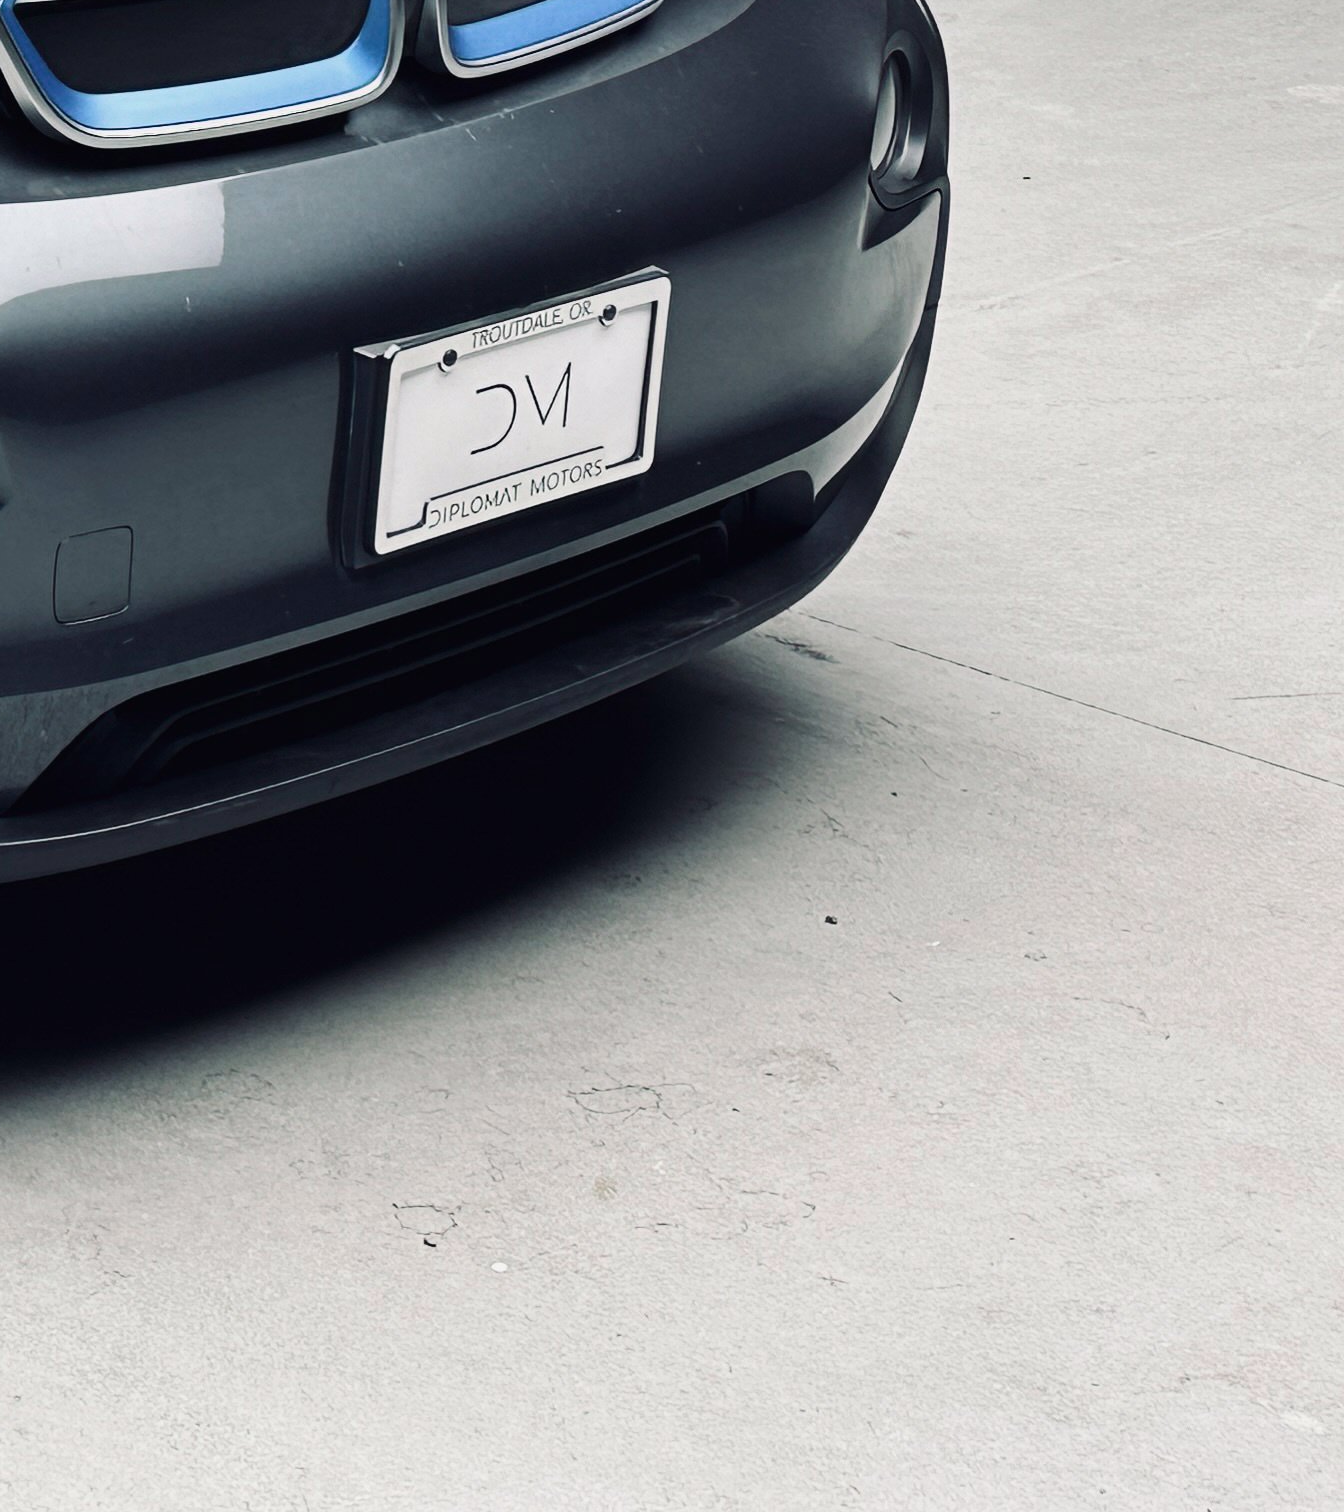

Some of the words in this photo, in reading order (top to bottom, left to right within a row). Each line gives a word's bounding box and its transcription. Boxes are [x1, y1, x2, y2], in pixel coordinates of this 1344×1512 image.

[471, 308, 564, 349] TROUTDALE
[569, 299, 594, 321] OR
[428, 482, 522, 529] DIPLOMAT
[529, 459, 603, 497] MOTORS
